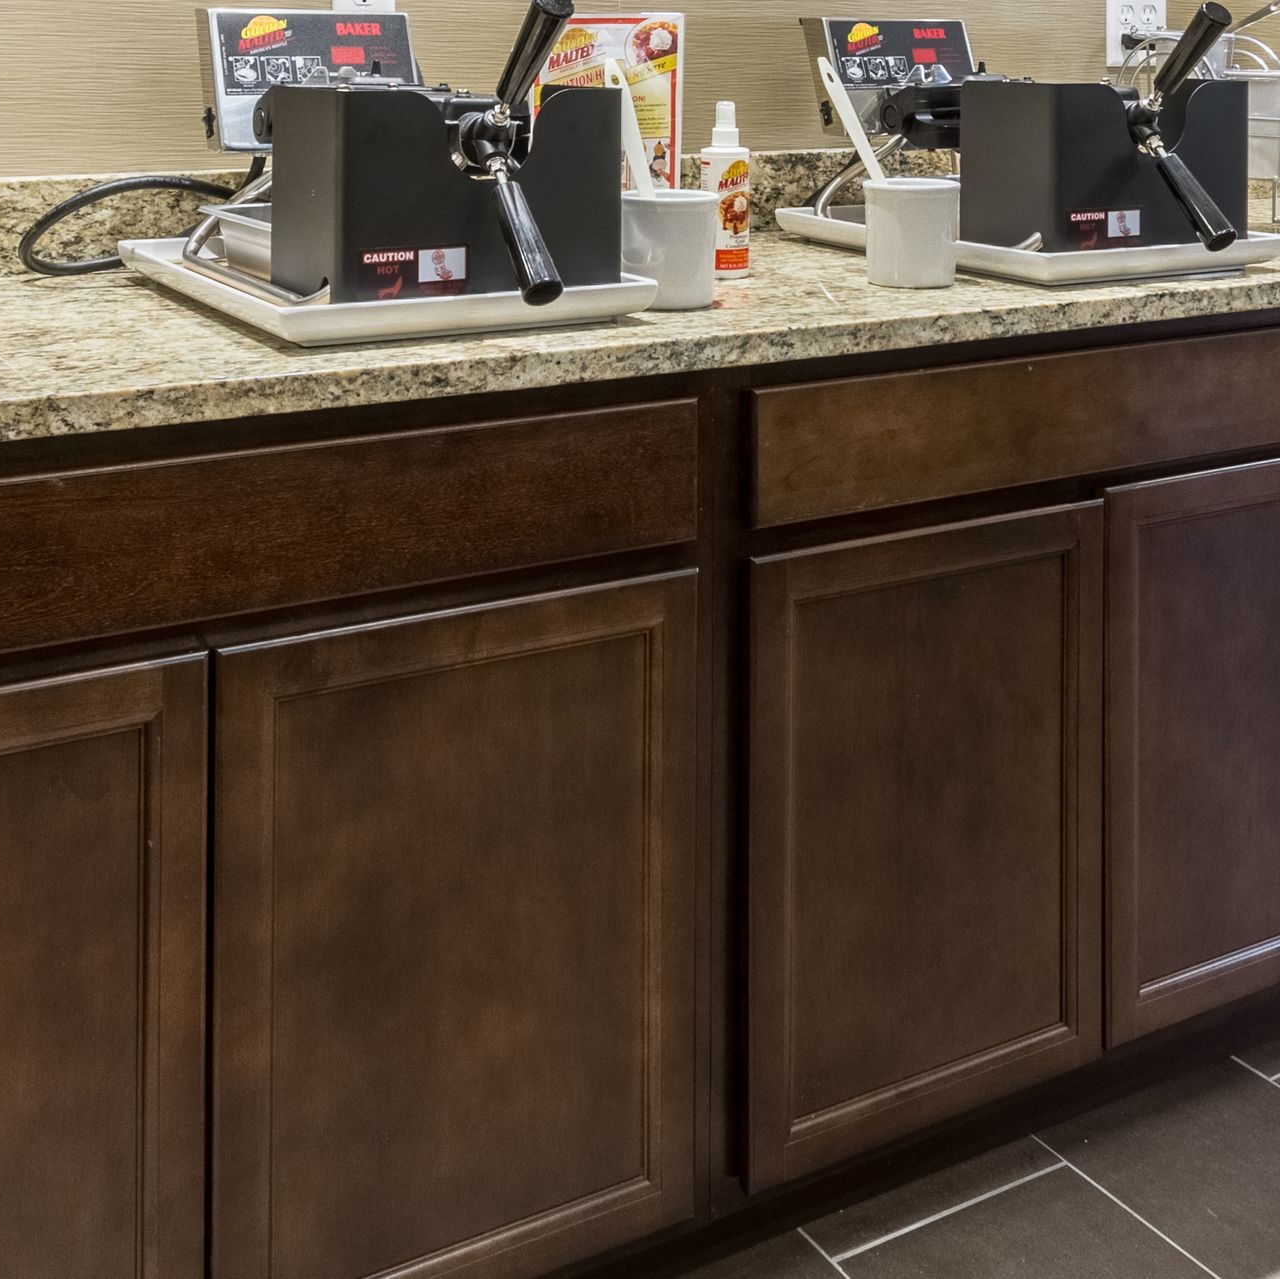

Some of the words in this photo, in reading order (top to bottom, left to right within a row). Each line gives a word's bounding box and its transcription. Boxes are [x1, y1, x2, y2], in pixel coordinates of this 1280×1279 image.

[335, 22, 382, 36] BAKER
[912, 28, 946, 39] BAKER
[548, 44, 595, 71] MALTED
[1070, 211, 1105, 221] CAUTION
[363, 251, 414, 264] CAUTION
[376, 265, 400, 275] HOT
